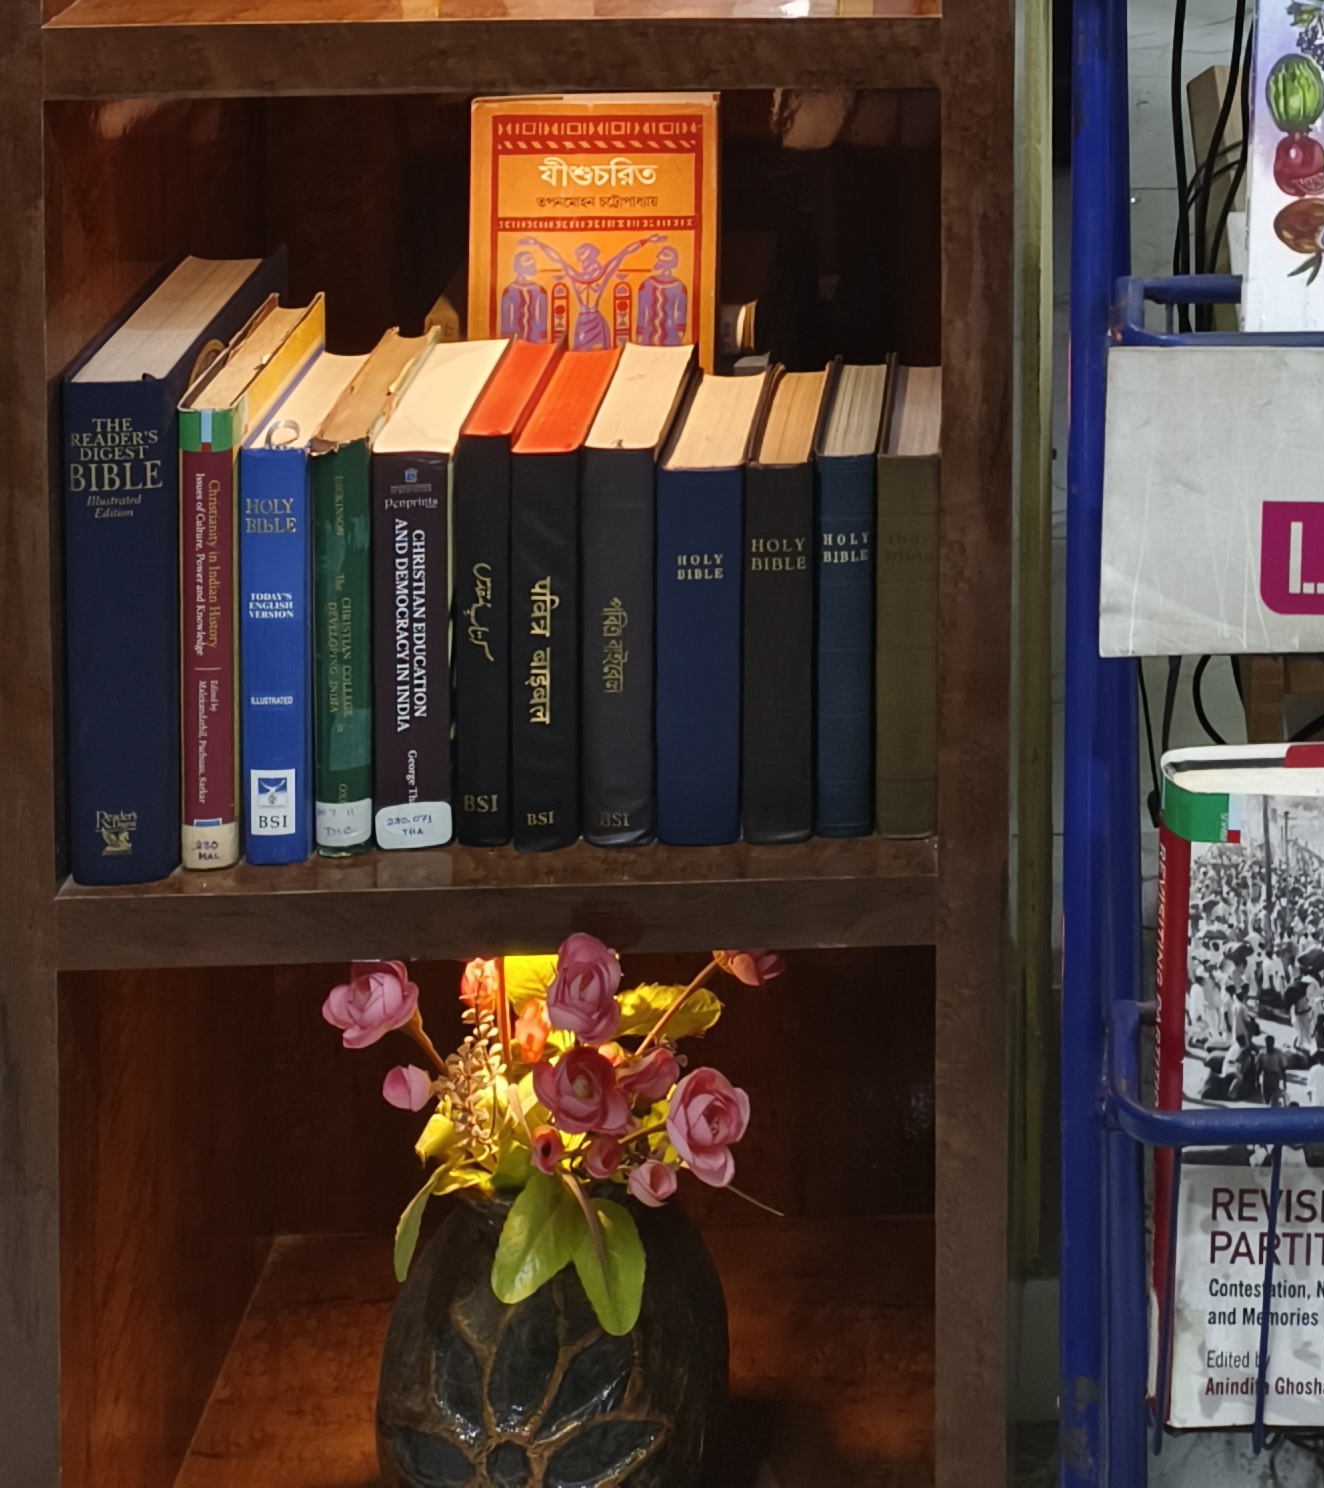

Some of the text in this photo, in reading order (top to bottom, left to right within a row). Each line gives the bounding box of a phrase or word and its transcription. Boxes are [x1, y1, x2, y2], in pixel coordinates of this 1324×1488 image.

[538, 157, 658, 188] যীশুচরিত
[92, 417, 134, 432] THE
[70, 430, 159, 447] READER'S
[79, 445, 150, 462] DIGEST
[68, 460, 164, 493] BIBLE
[194, 473, 205, 501] Issues
[86, 494, 142, 507] Illustrated
[195, 502, 206, 513] of
[246, 498, 294, 515] HOLY
[94, 507, 134, 519] Edition
[751, 537, 807, 553] HOLY
[822, 531, 870, 546] HOLY
[206, 479, 221, 649] Christianity in Indian History
[677, 553, 724, 567] HOLY
[751, 556, 807, 572] BIBLE
[822, 548, 869, 563] BIBLE
[194, 553, 206, 585] Power
[677, 568, 724, 580] BIBLE
[194, 585, 206, 603] and
[250, 592, 293, 601] TODAY'S
[249, 601, 293, 610] ENGLISH
[249, 610, 294, 619] VERSION
[411, 529, 427, 717] CHRISTIAN EDUCATION
[193, 605, 206, 656] Knowledge
[340, 597, 352, 660] CHRISTIAN
[394, 518, 410, 732] AND DEMOCRACY IN INDIA
[525, 576, 560, 725] पवित्र बाइबल
[601, 597, 629, 694] পবিত্র বাইবেল
[250, 695, 294, 706] ILLUSTRATED
[405, 749, 418, 785] George
[463, 794, 499, 813] BSI
[258, 815, 288, 830] BSI
[527, 811, 554, 827] BSI
[600, 811, 630, 828] BSI
[1208, 1278, 1311, 1301] Contesation,
[1207, 1307, 1237, 1326] and
[1206, 1350, 1250, 1369] Edited
